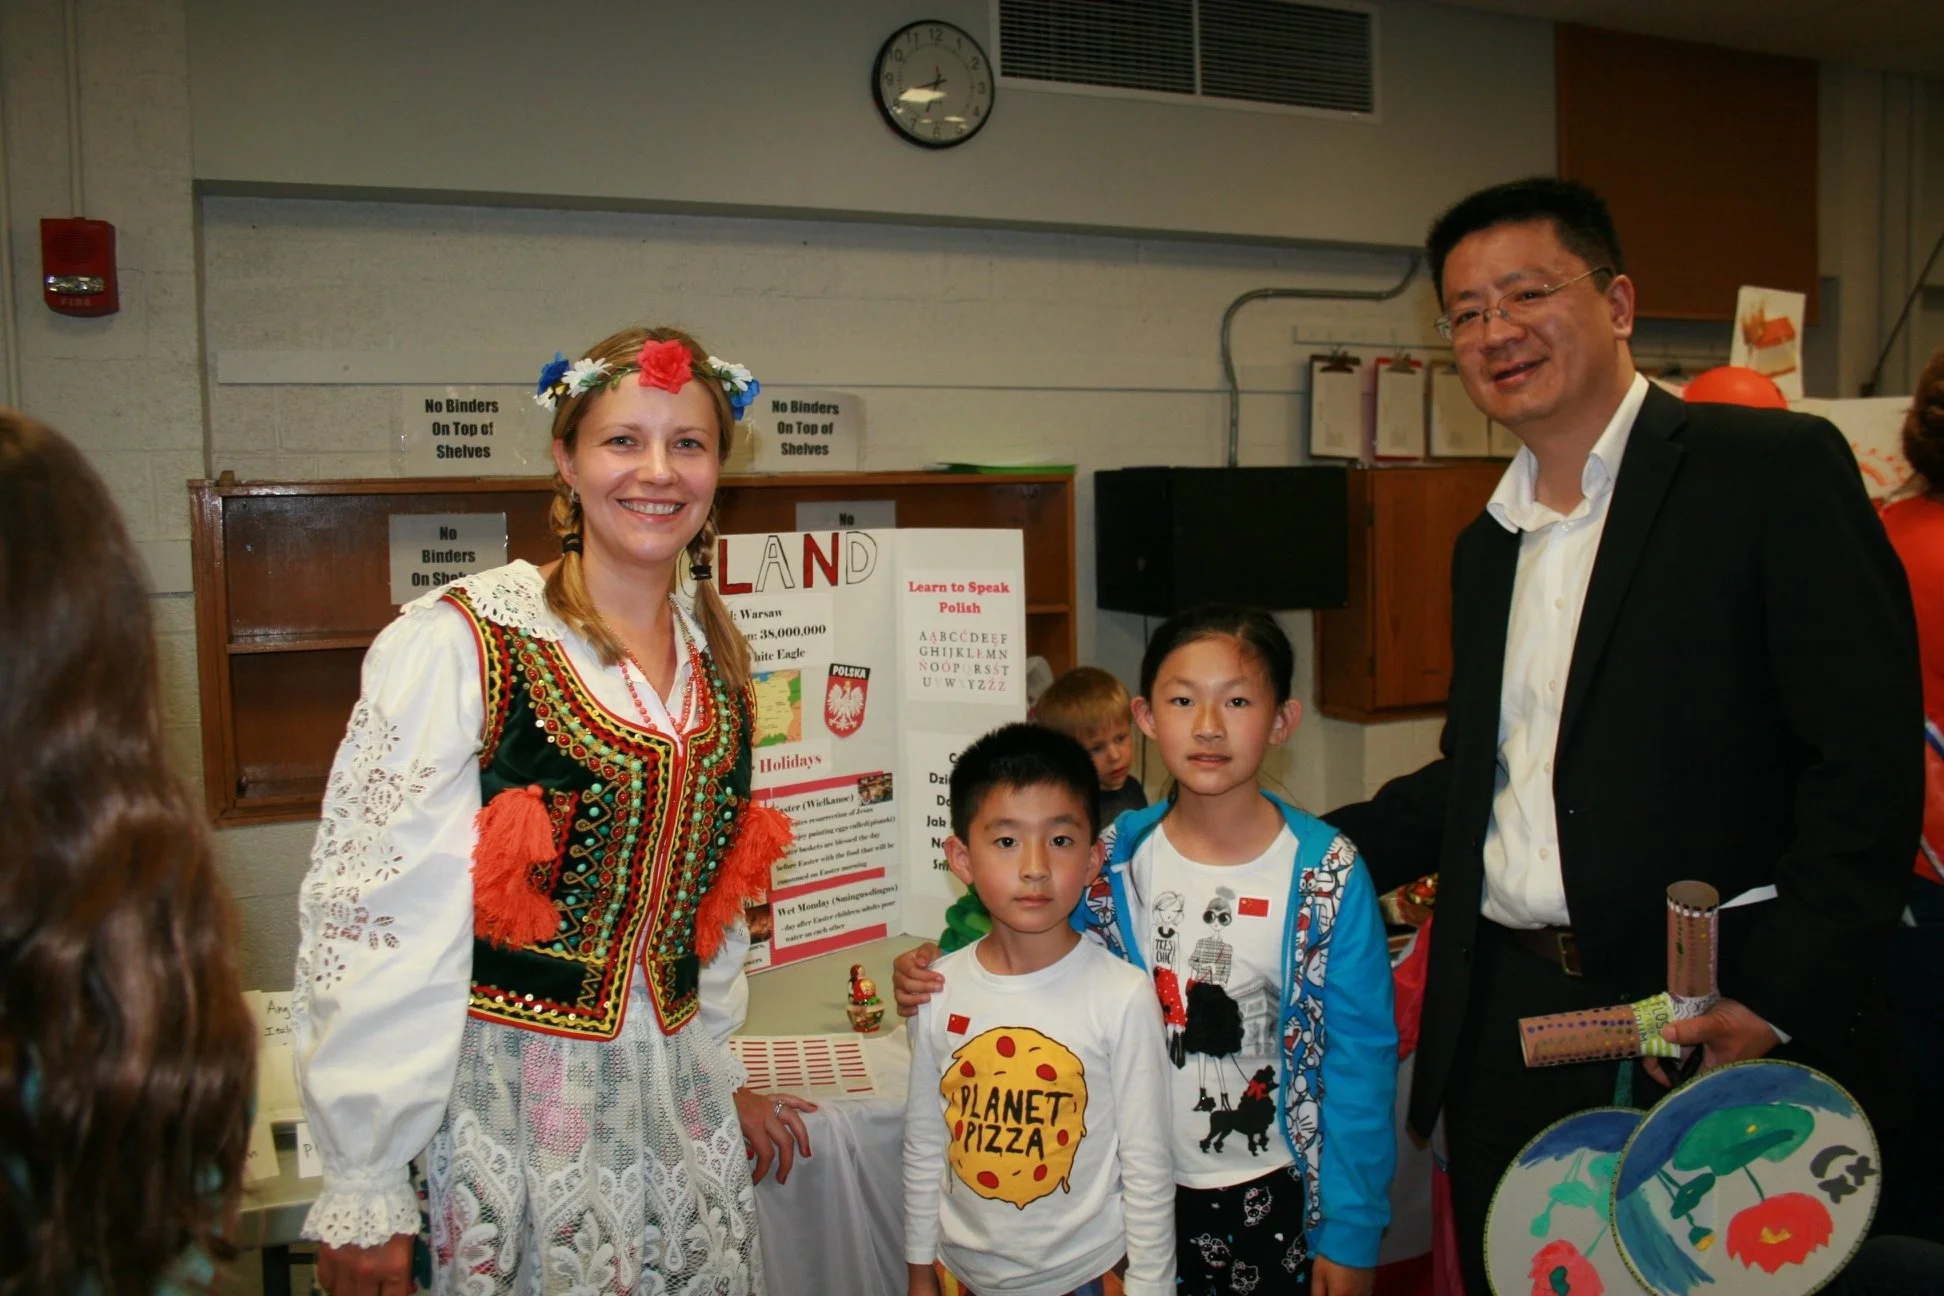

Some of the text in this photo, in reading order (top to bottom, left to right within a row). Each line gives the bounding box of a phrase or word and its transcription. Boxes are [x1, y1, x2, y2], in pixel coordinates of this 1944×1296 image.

[905, 31, 919, 45] 11
[928, 28, 944, 42] 12
[889, 49, 904, 63] 10
[971, 56, 980, 70] 2
[884, 72, 894, 86] 9
[977, 82, 986, 95] 3
[972, 105, 980, 117] 4
[910, 117, 919, 131] 7
[932, 125, 942, 138] 6
[60, 297, 93, 307] FIRE
[425, 399, 499, 414] No Binders
[772, 400, 839, 415] No Binders
[432, 421, 494, 437] On Top of
[777, 421, 834, 436] On Top of
[436, 444, 491, 459] Shelves
[781, 442, 829, 456] Shelves
[839, 513, 855, 526] No
[440, 526, 458, 540] No
[422, 550, 476, 563] Binders
[411, 572, 430, 587] On
[908, 581, 1010, 595] Learn to Speak
[739, 609, 783, 620] Warsaw
[939, 602, 981, 614] Polish
[760, 624, 827, 640] 38,000,000
[754, 647, 806, 662] hite Eagle
[832, 665, 867, 679] POLSKA
[759, 753, 822, 774] Holidays
[929, 772, 951, 785] Dzi
[809, 811, 848, 824] resurrection
[849, 809, 855, 817] of
[926, 815, 946, 828] Jak
[808, 827, 834, 840] painting
[835, 825, 849, 834] eggs
[799, 843, 823, 854] baskets
[835, 835, 858, 846] blessed
[870, 832, 880, 840] day
[776, 863, 797, 872] before
[798, 858, 819, 868] Easter
[820, 867, 840, 877] Easter
[778, 906, 796, 917] Wet
[797, 899, 830, 912] Monday
[784, 923, 796, 932] day
[813, 914, 834, 924] Easter
[785, 933, 803, 942] water
[813, 927, 828, 936] each
[829, 923, 845, 932] other
[267, 999, 292, 1020] Ang
[960, 1083, 1074, 1127] PLANET
[964, 1120, 1045, 1161] PIZZA
